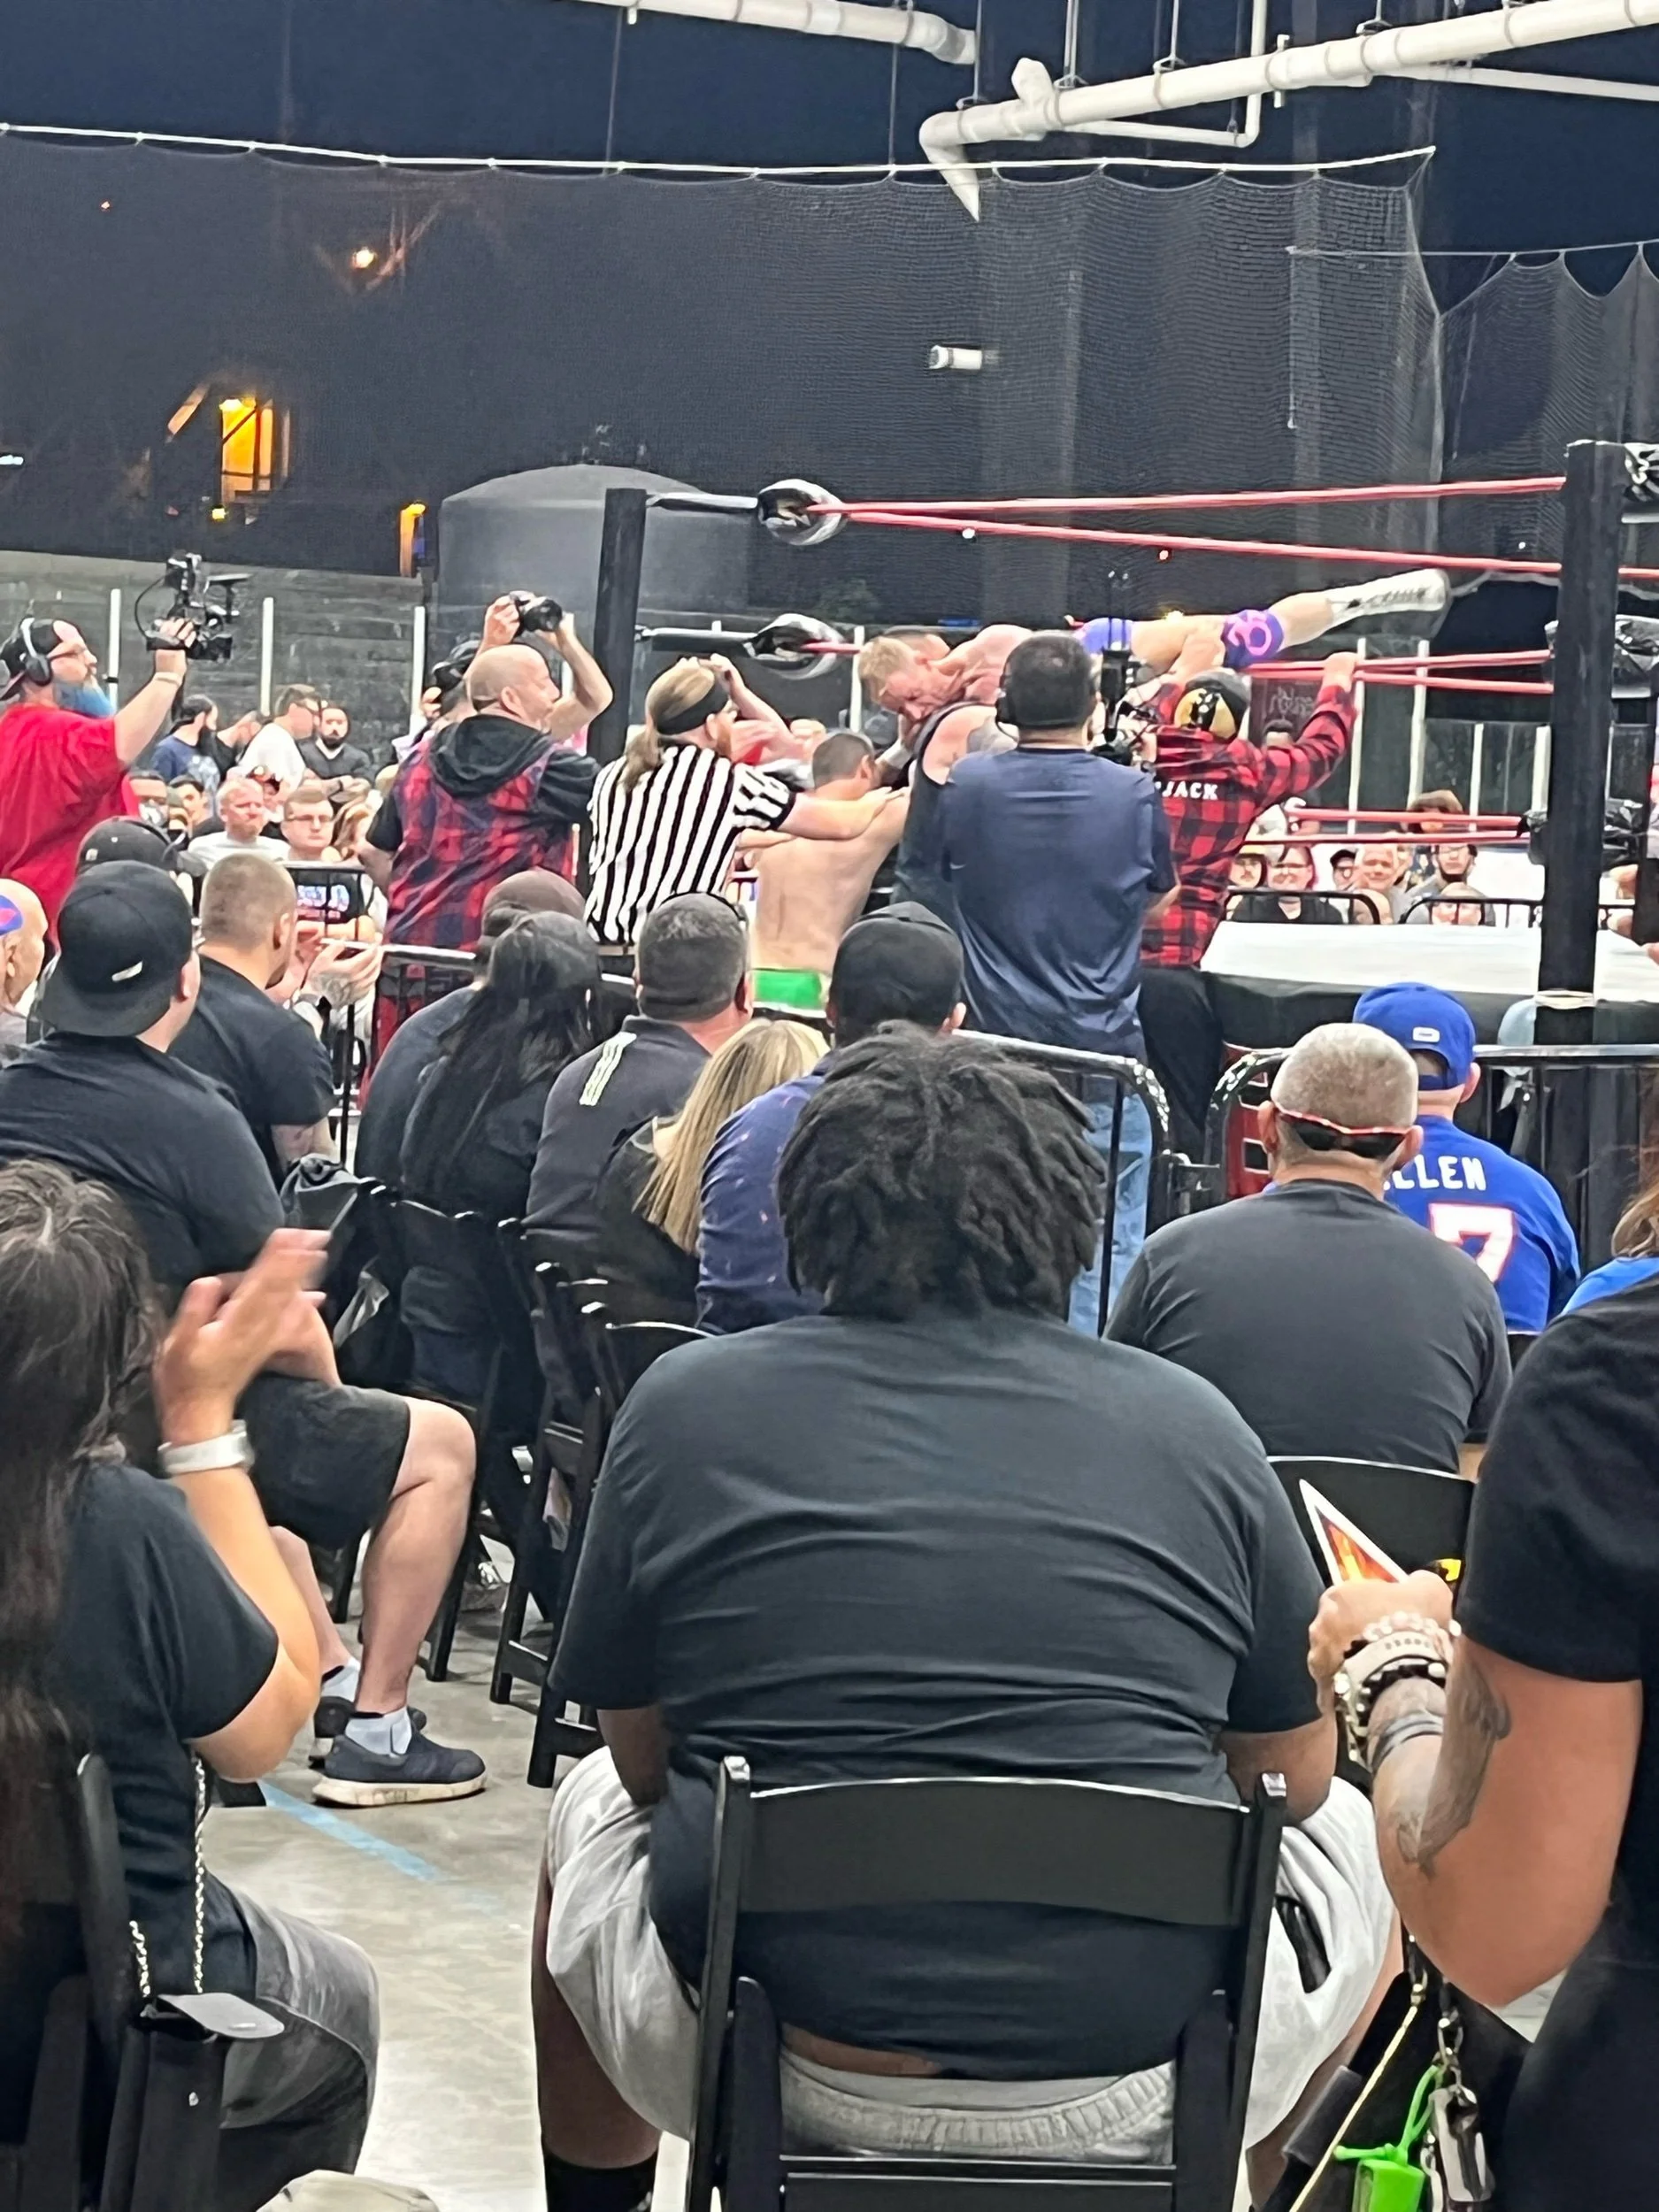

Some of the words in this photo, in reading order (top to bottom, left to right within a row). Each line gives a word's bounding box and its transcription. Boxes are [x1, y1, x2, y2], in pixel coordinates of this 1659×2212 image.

[1155, 780, 1218, 801] JACK
[1383, 1154, 1486, 1191] LLEN
[1427, 1202, 1517, 1284] 7
